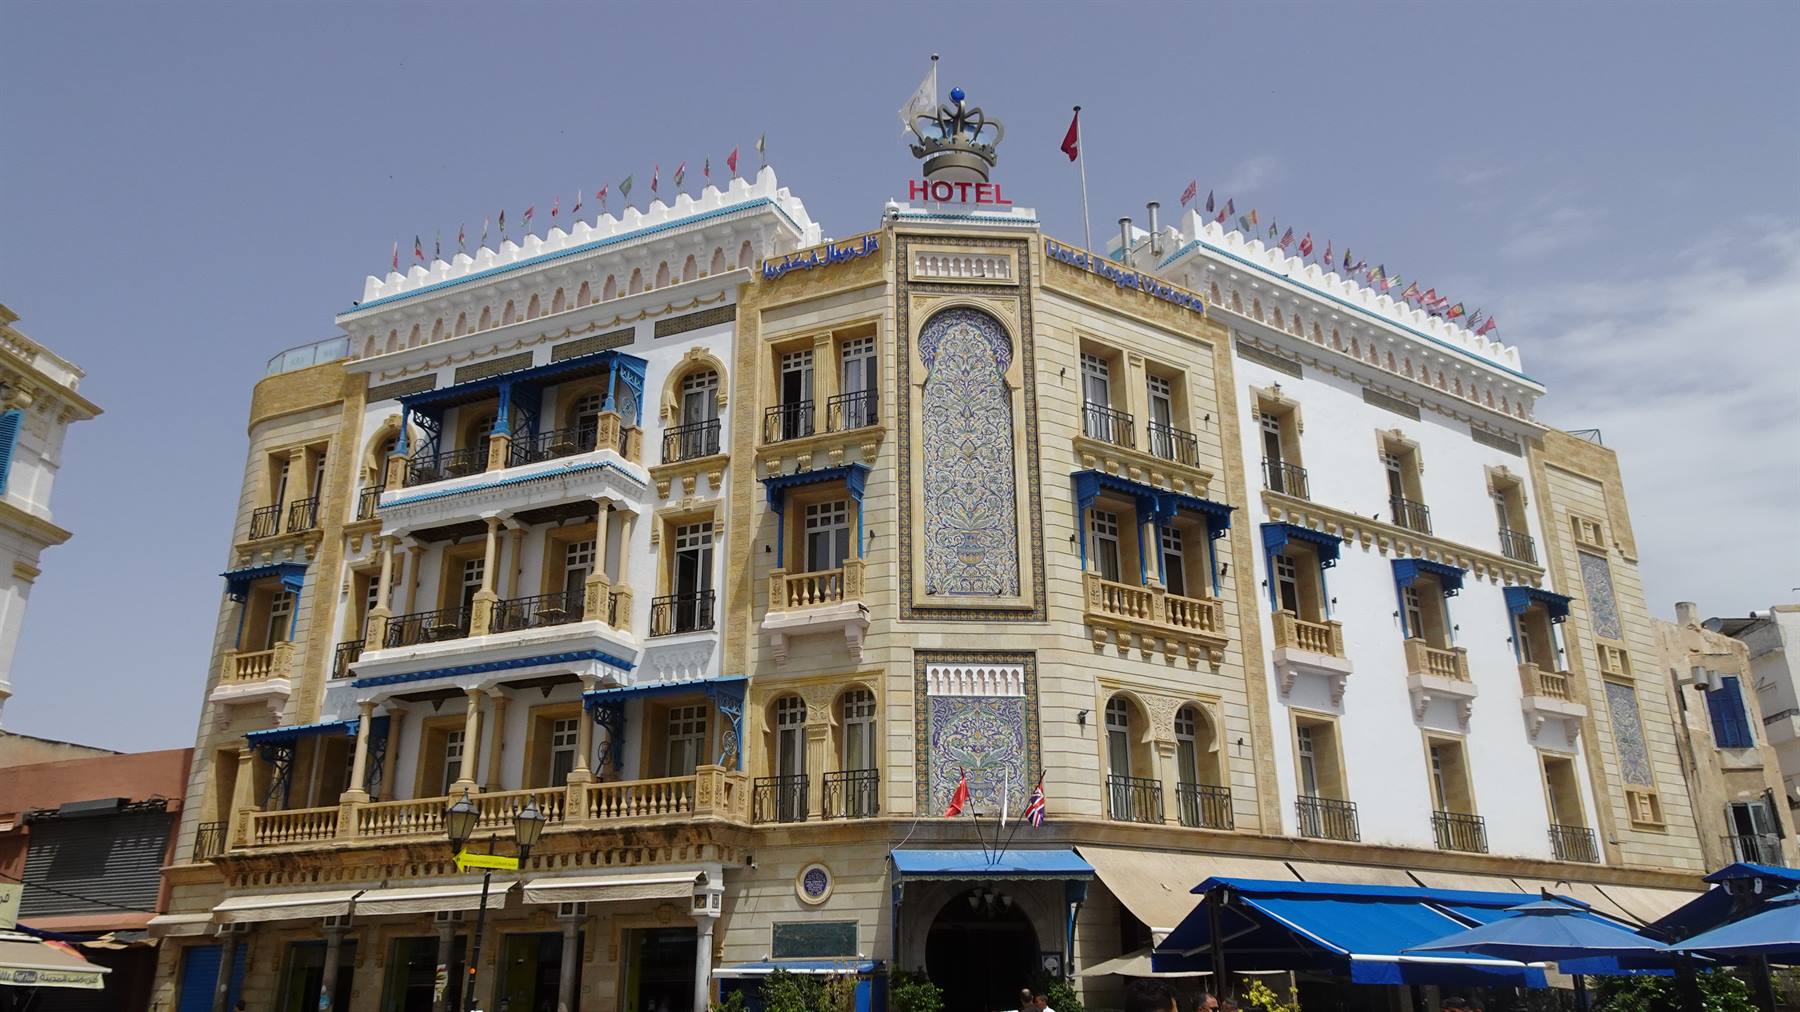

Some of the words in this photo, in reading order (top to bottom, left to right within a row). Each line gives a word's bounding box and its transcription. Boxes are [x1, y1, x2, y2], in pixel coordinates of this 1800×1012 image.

[909, 180, 1012, 205] HOTEL
[1046, 239, 1089, 271] Hotel
[1093, 256, 1140, 290] Royal
[1142, 275, 1205, 314] Victoria
